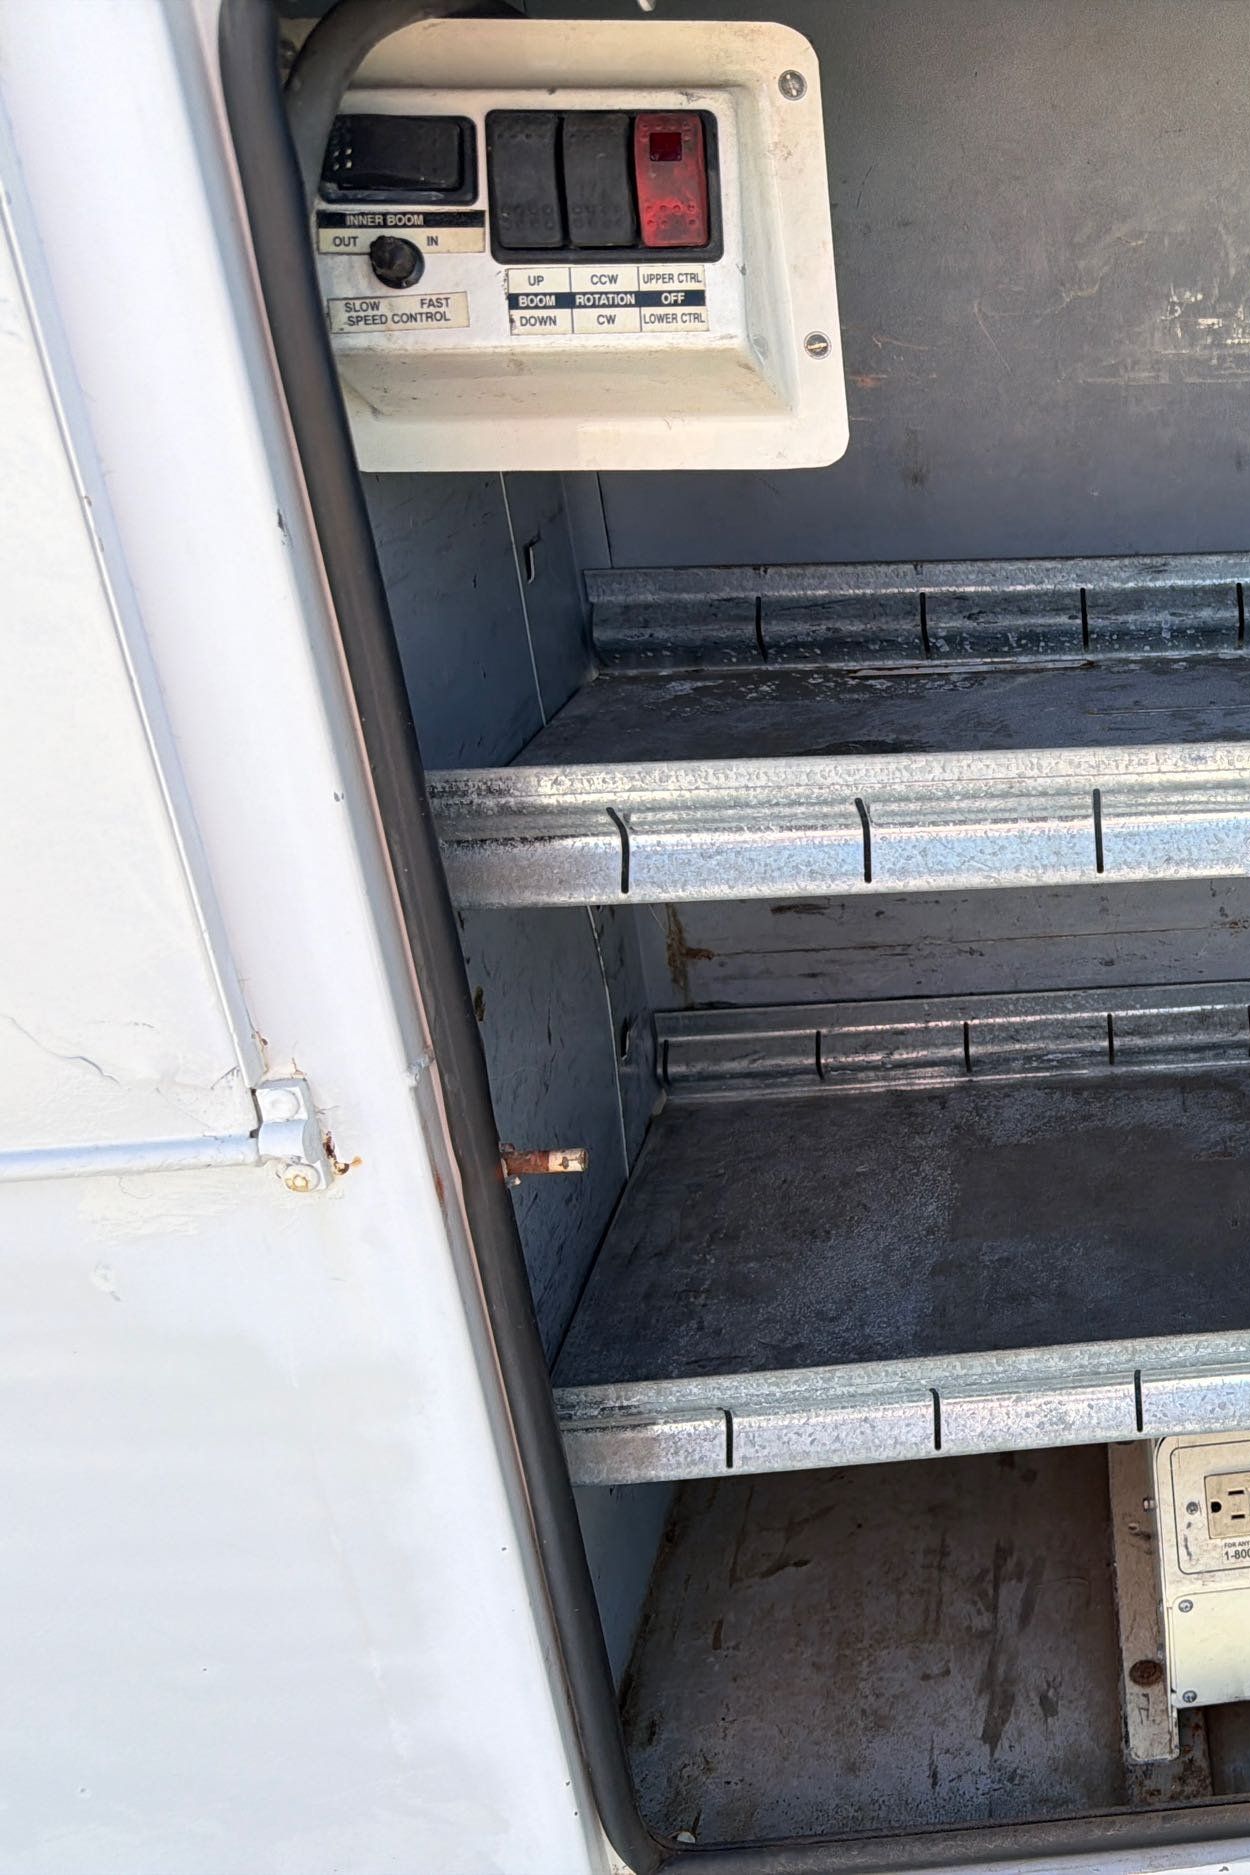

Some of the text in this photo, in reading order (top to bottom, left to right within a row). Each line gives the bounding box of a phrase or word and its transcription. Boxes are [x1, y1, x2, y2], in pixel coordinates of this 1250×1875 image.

[346, 214, 424, 226] INNER BOOM
[332, 236, 359, 247] OUT
[427, 236, 439, 247] IN
[527, 275, 545, 286] UP
[590, 274, 619, 285] CCW
[642, 272, 702, 284] UPPER CTRL
[420, 297, 451, 309] FAST
[518, 295, 556, 307] BOOM
[575, 294, 636, 306] ROTATION
[661, 292, 686, 304] OFF
[344, 301, 381, 313] SLOW
[346, 311, 451, 327] SPEED CONTROL
[519, 315, 557, 327] DOWN
[596, 314, 617, 325] CW
[643, 312, 706, 324] LOWER CTRL
[1224, 1541, 1237, 1549] FOR
[1238, 1540, 1250, 1548] ANY
